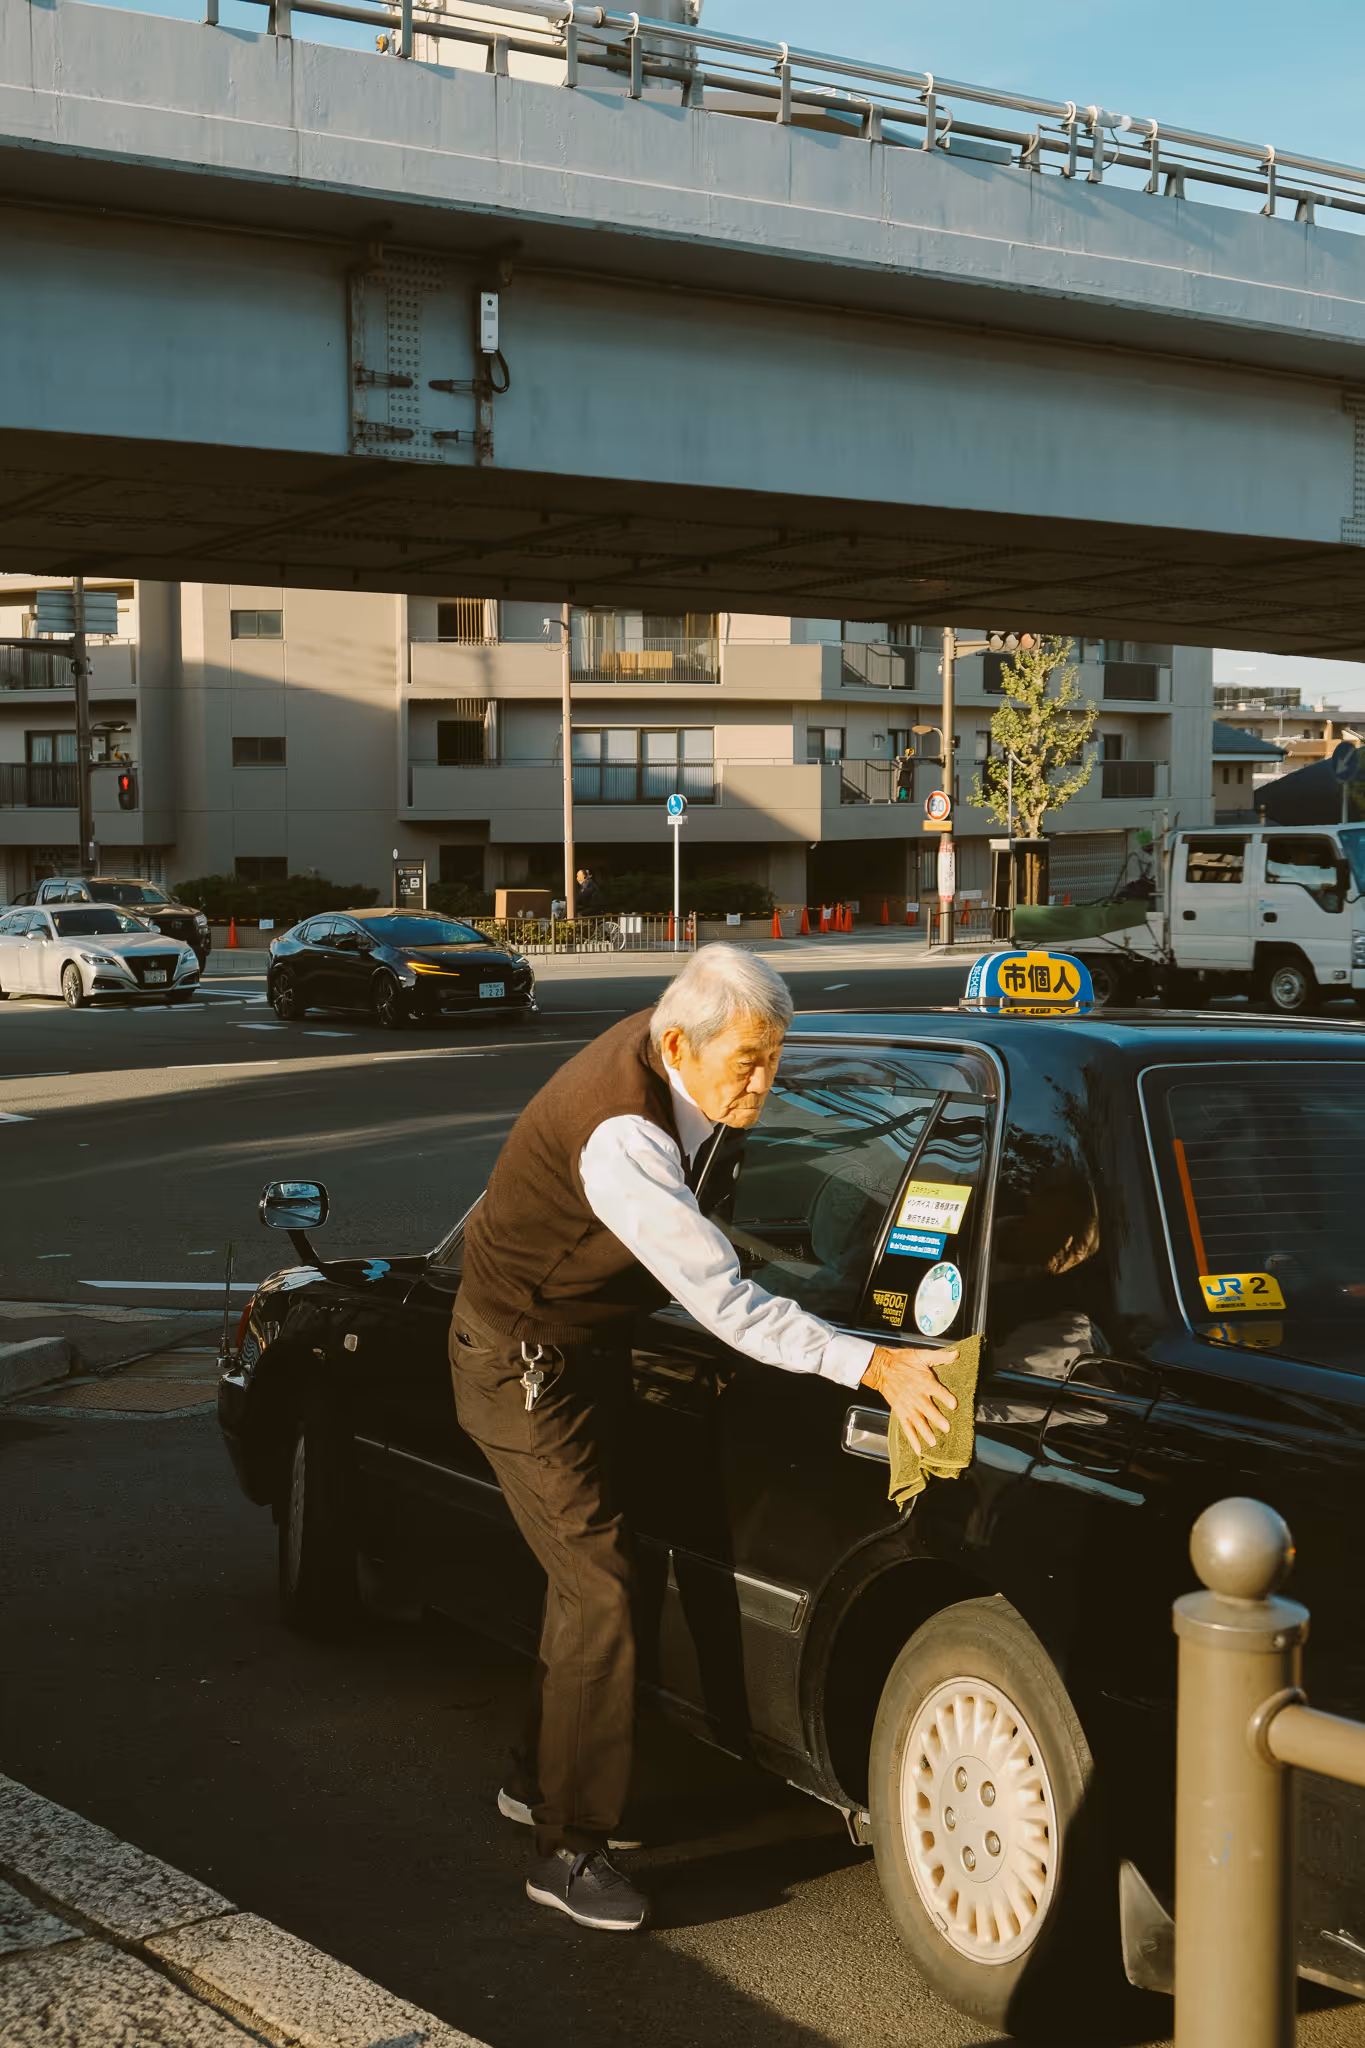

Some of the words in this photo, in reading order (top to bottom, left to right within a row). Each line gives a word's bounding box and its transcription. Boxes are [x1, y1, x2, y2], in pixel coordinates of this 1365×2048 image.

[1003, 963, 1075, 994] 市個人
[1206, 1278, 1244, 1296] JR
[1249, 1277, 1269, 1294] 2
